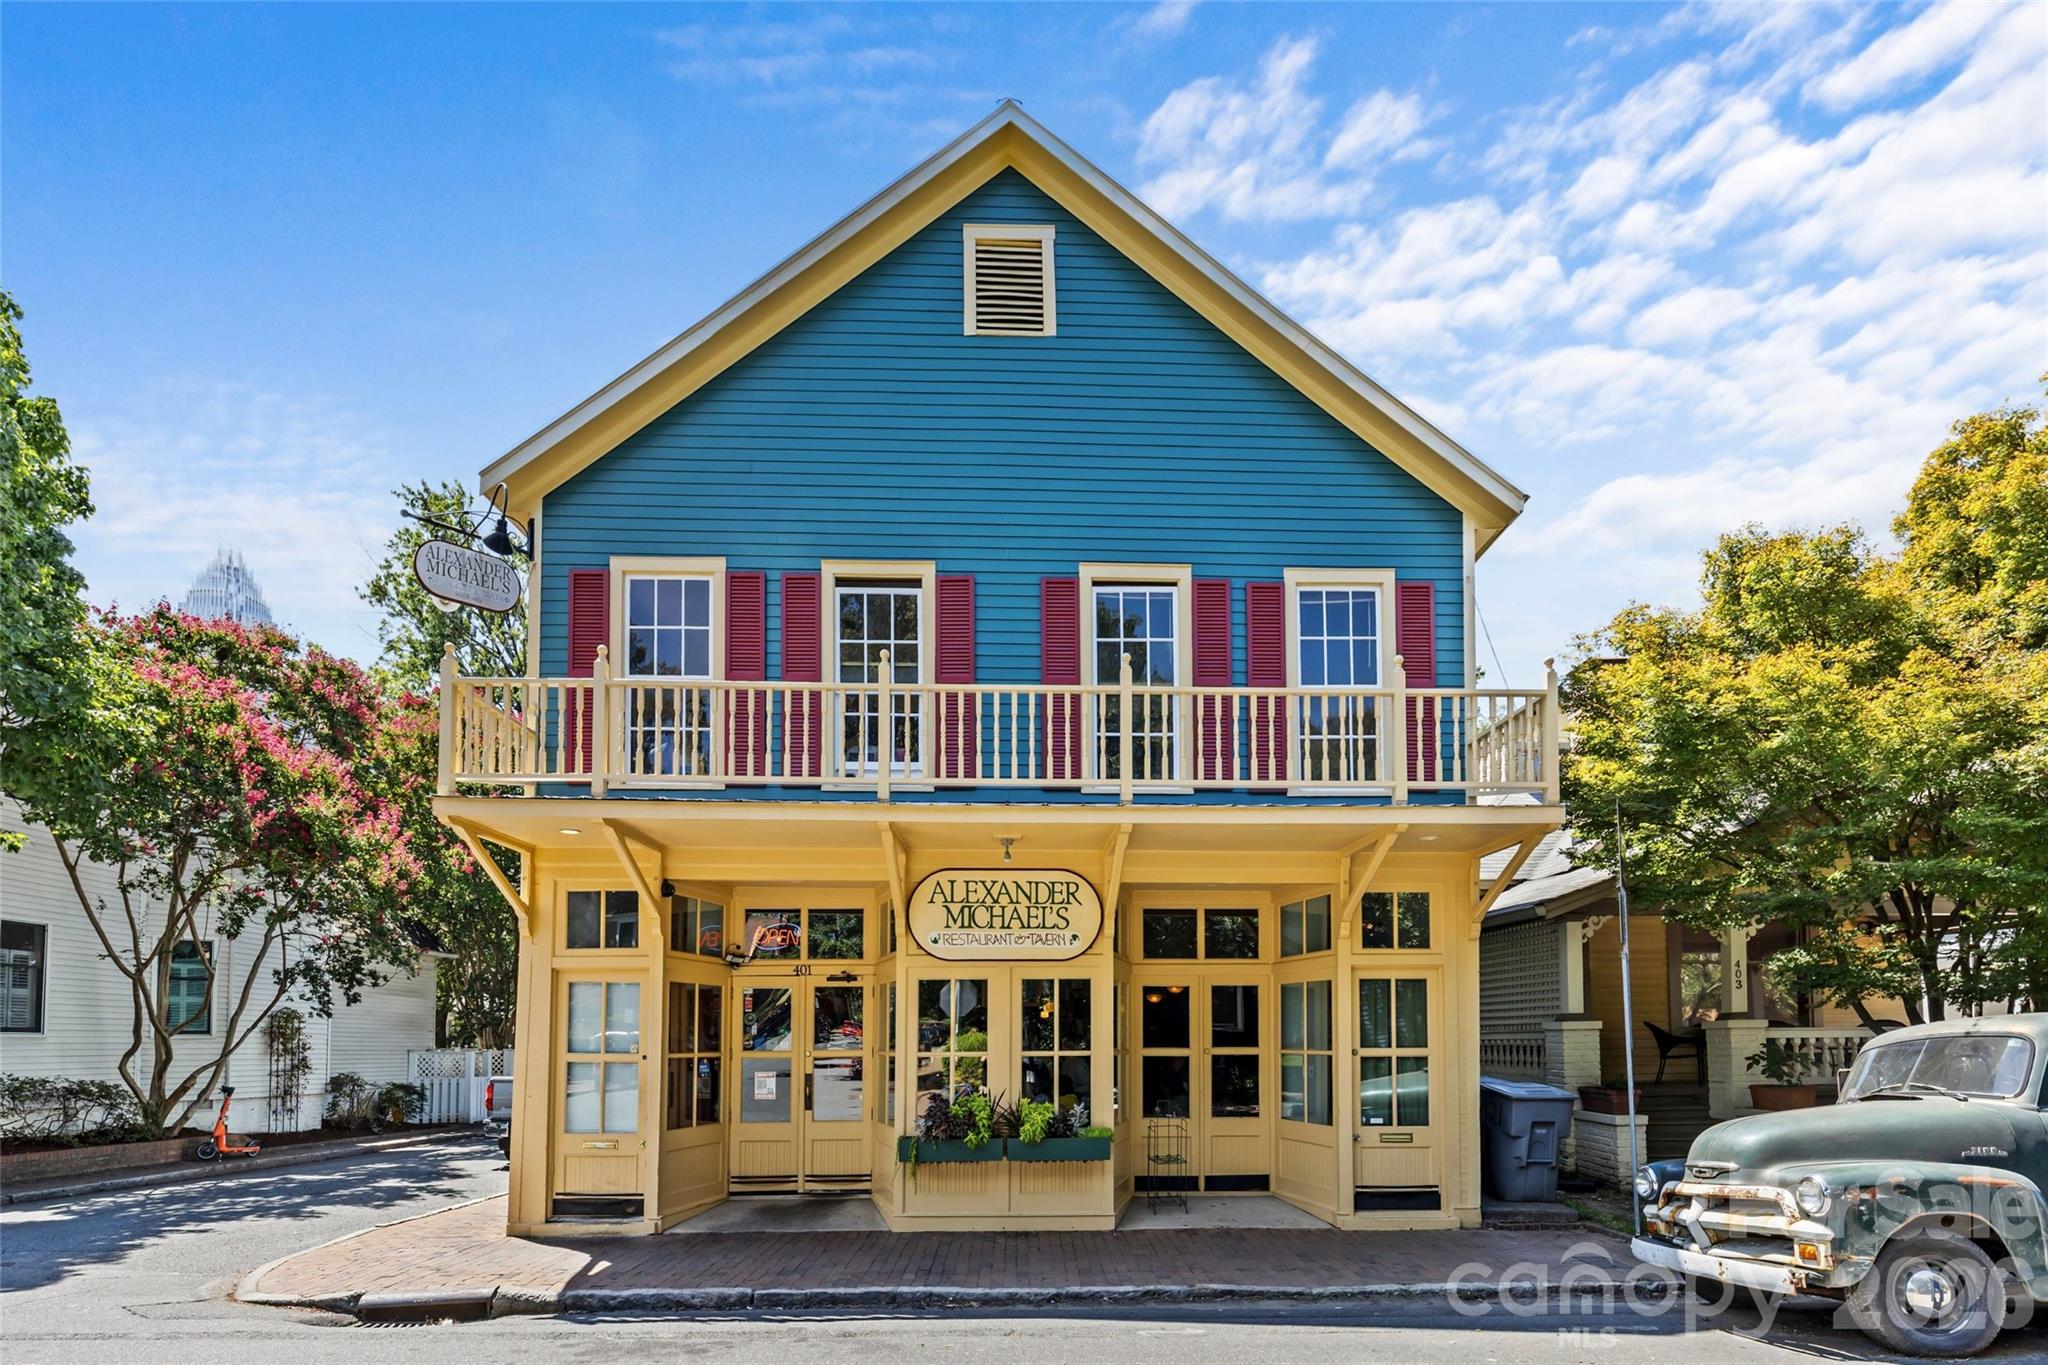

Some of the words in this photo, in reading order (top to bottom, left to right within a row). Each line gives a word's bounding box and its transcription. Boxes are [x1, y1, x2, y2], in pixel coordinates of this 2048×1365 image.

[425, 545, 511, 581] ALEXANDER
[426, 559, 511, 595] MICHAEL'S
[928, 880, 1083, 906] ALEXANDER
[942, 905, 1070, 930] MICHAEL'S
[754, 927, 801, 947] OPEN
[942, 932, 1014, 946] RESTAURANT
[1029, 932, 1067, 946] TAVERN
[792, 964, 813, 977] 401
[1734, 959, 1743, 990] 403
